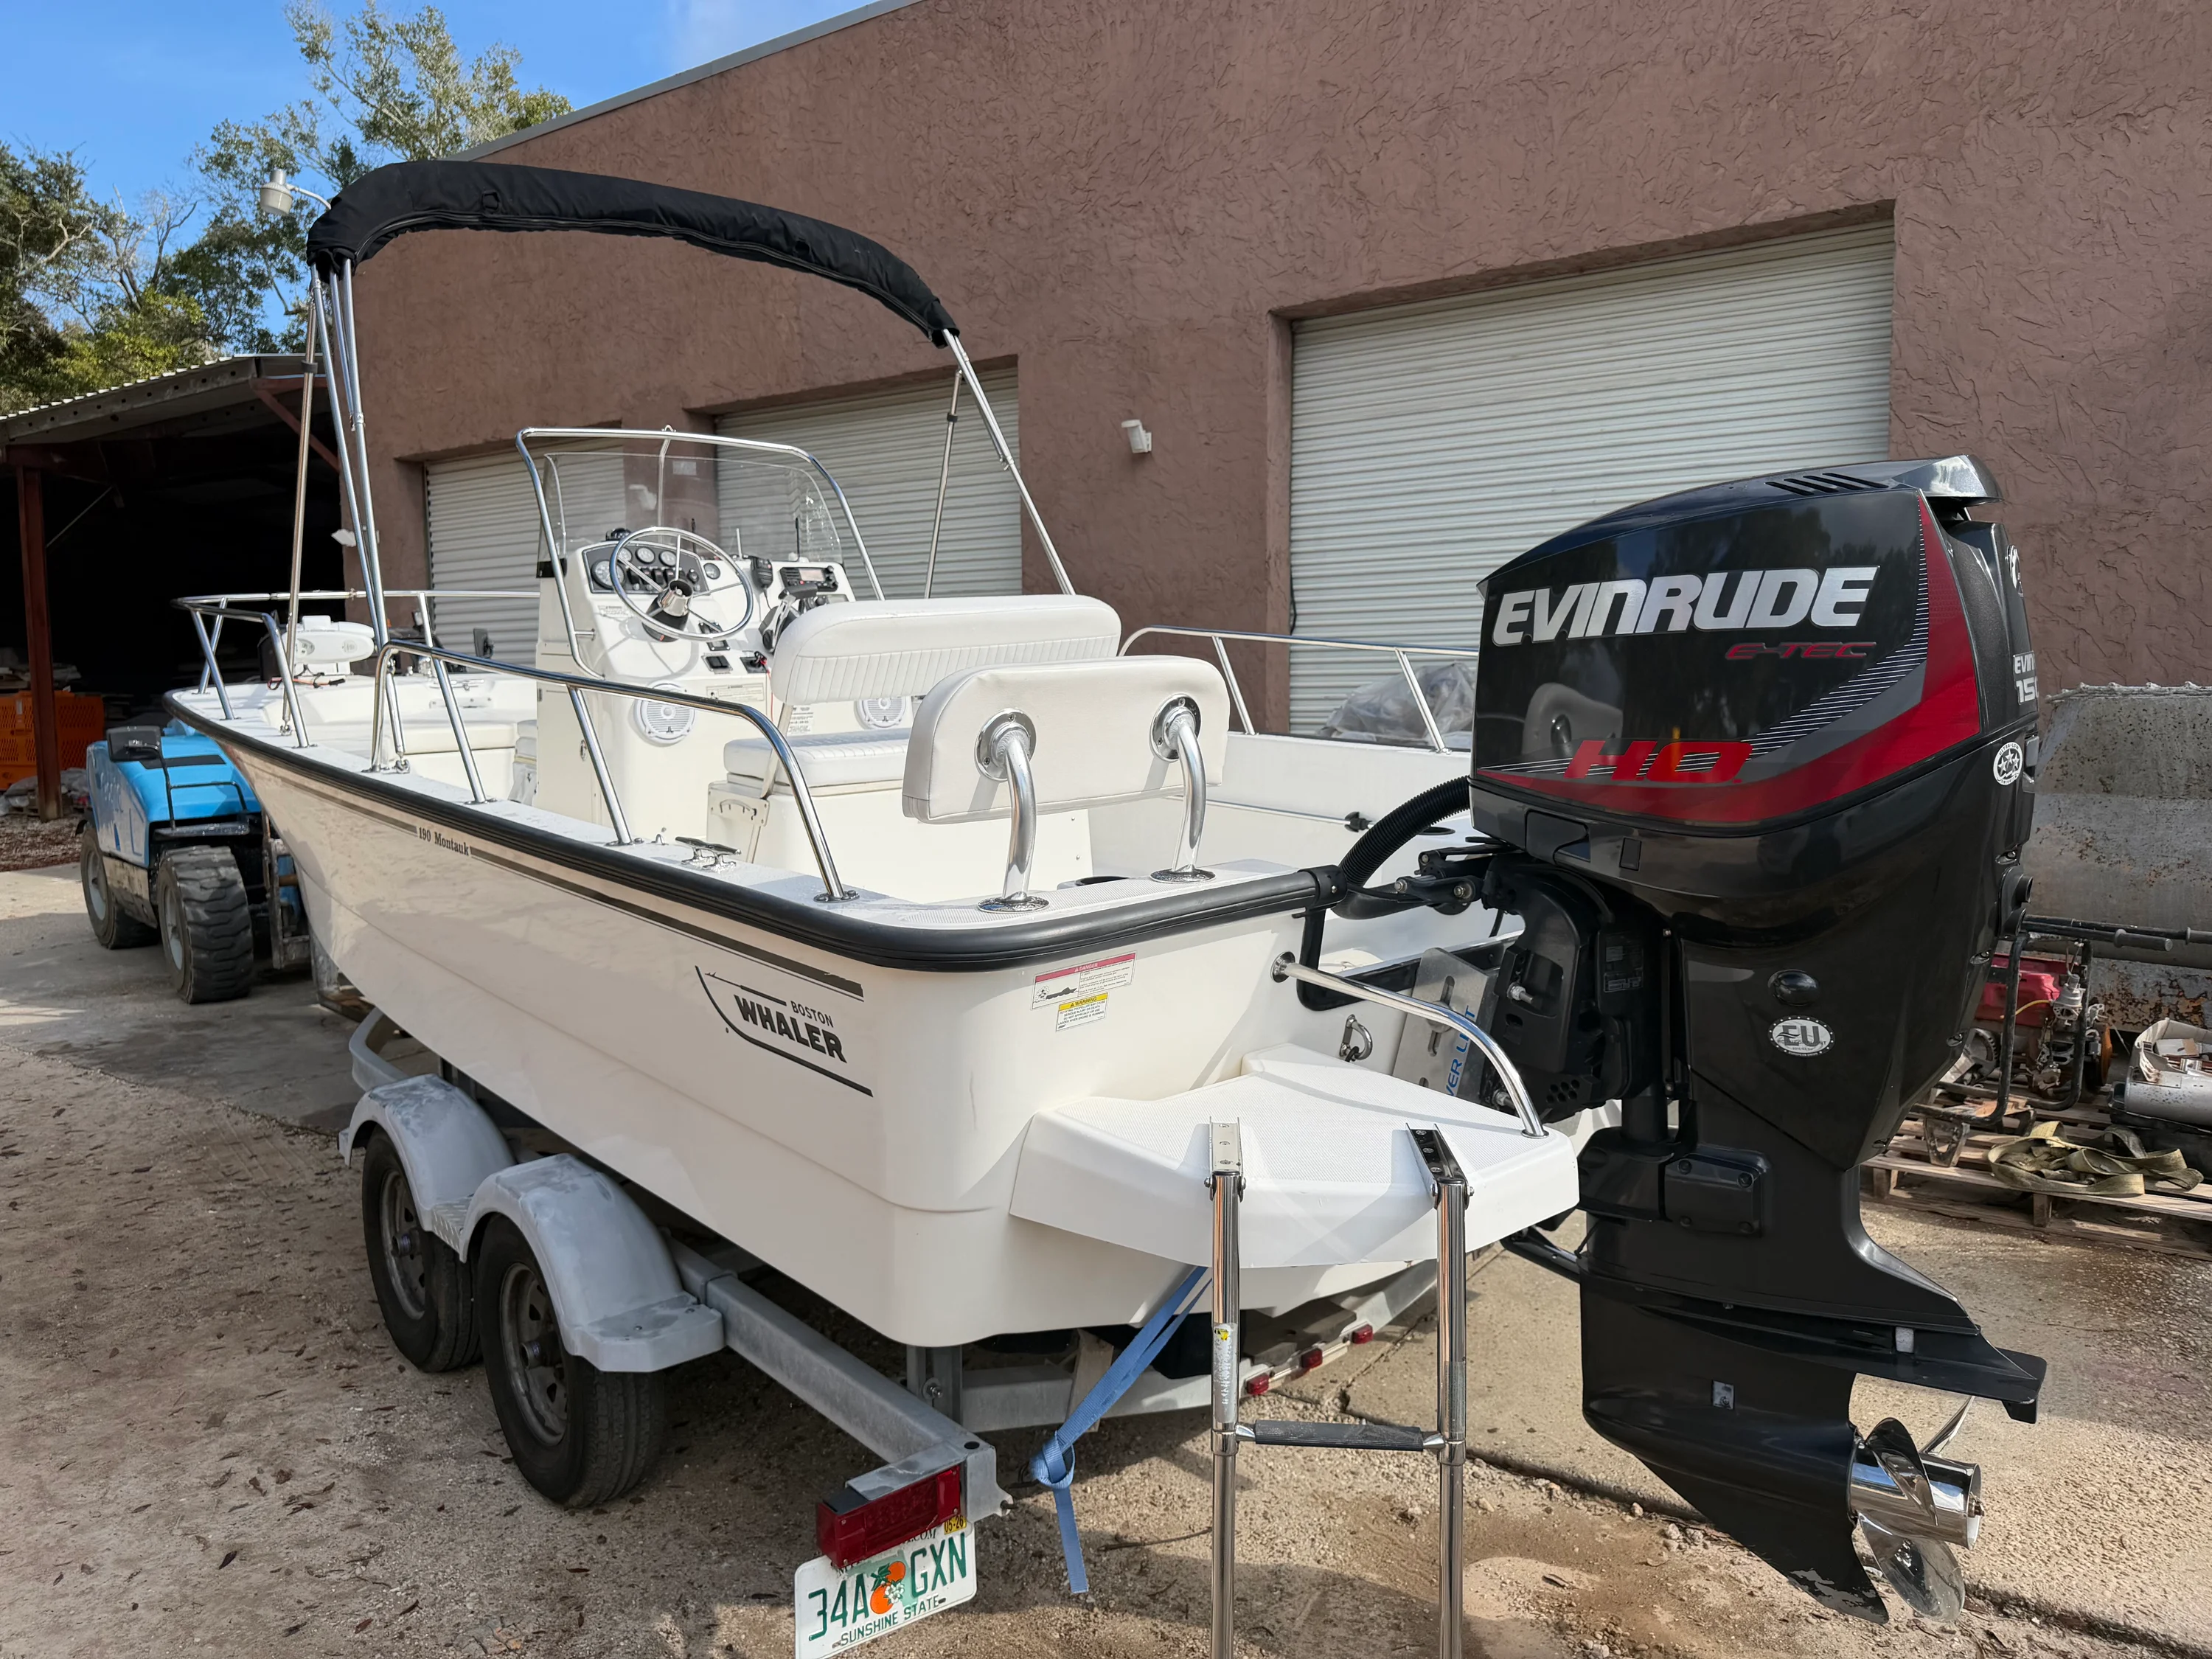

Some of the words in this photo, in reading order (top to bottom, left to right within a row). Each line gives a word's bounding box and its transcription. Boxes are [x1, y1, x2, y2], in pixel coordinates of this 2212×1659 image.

[1492, 566, 1880, 646] EVINRUDE
[1725, 642, 1877, 659] E-TEC
[419, 827, 431, 842] 190
[434, 831, 469, 856] Montauk
[1079, 963, 1098, 972] DANGER
[790, 1001, 834, 1028] BOSTON
[1075, 996, 1097, 1006] WARNING
[734, 994, 847, 1063] WHALER
[1456, 1005, 1475, 1053] LIT
[1781, 1025, 1820, 1046] EU
[944, 1515, 964, 1534] 05-26
[808, 1573, 870, 1642] 34A
[910, 1531, 967, 1599] GXN
[840, 1611, 898, 1646] SUNSHINE
[903, 1593, 940, 1621] STATE
